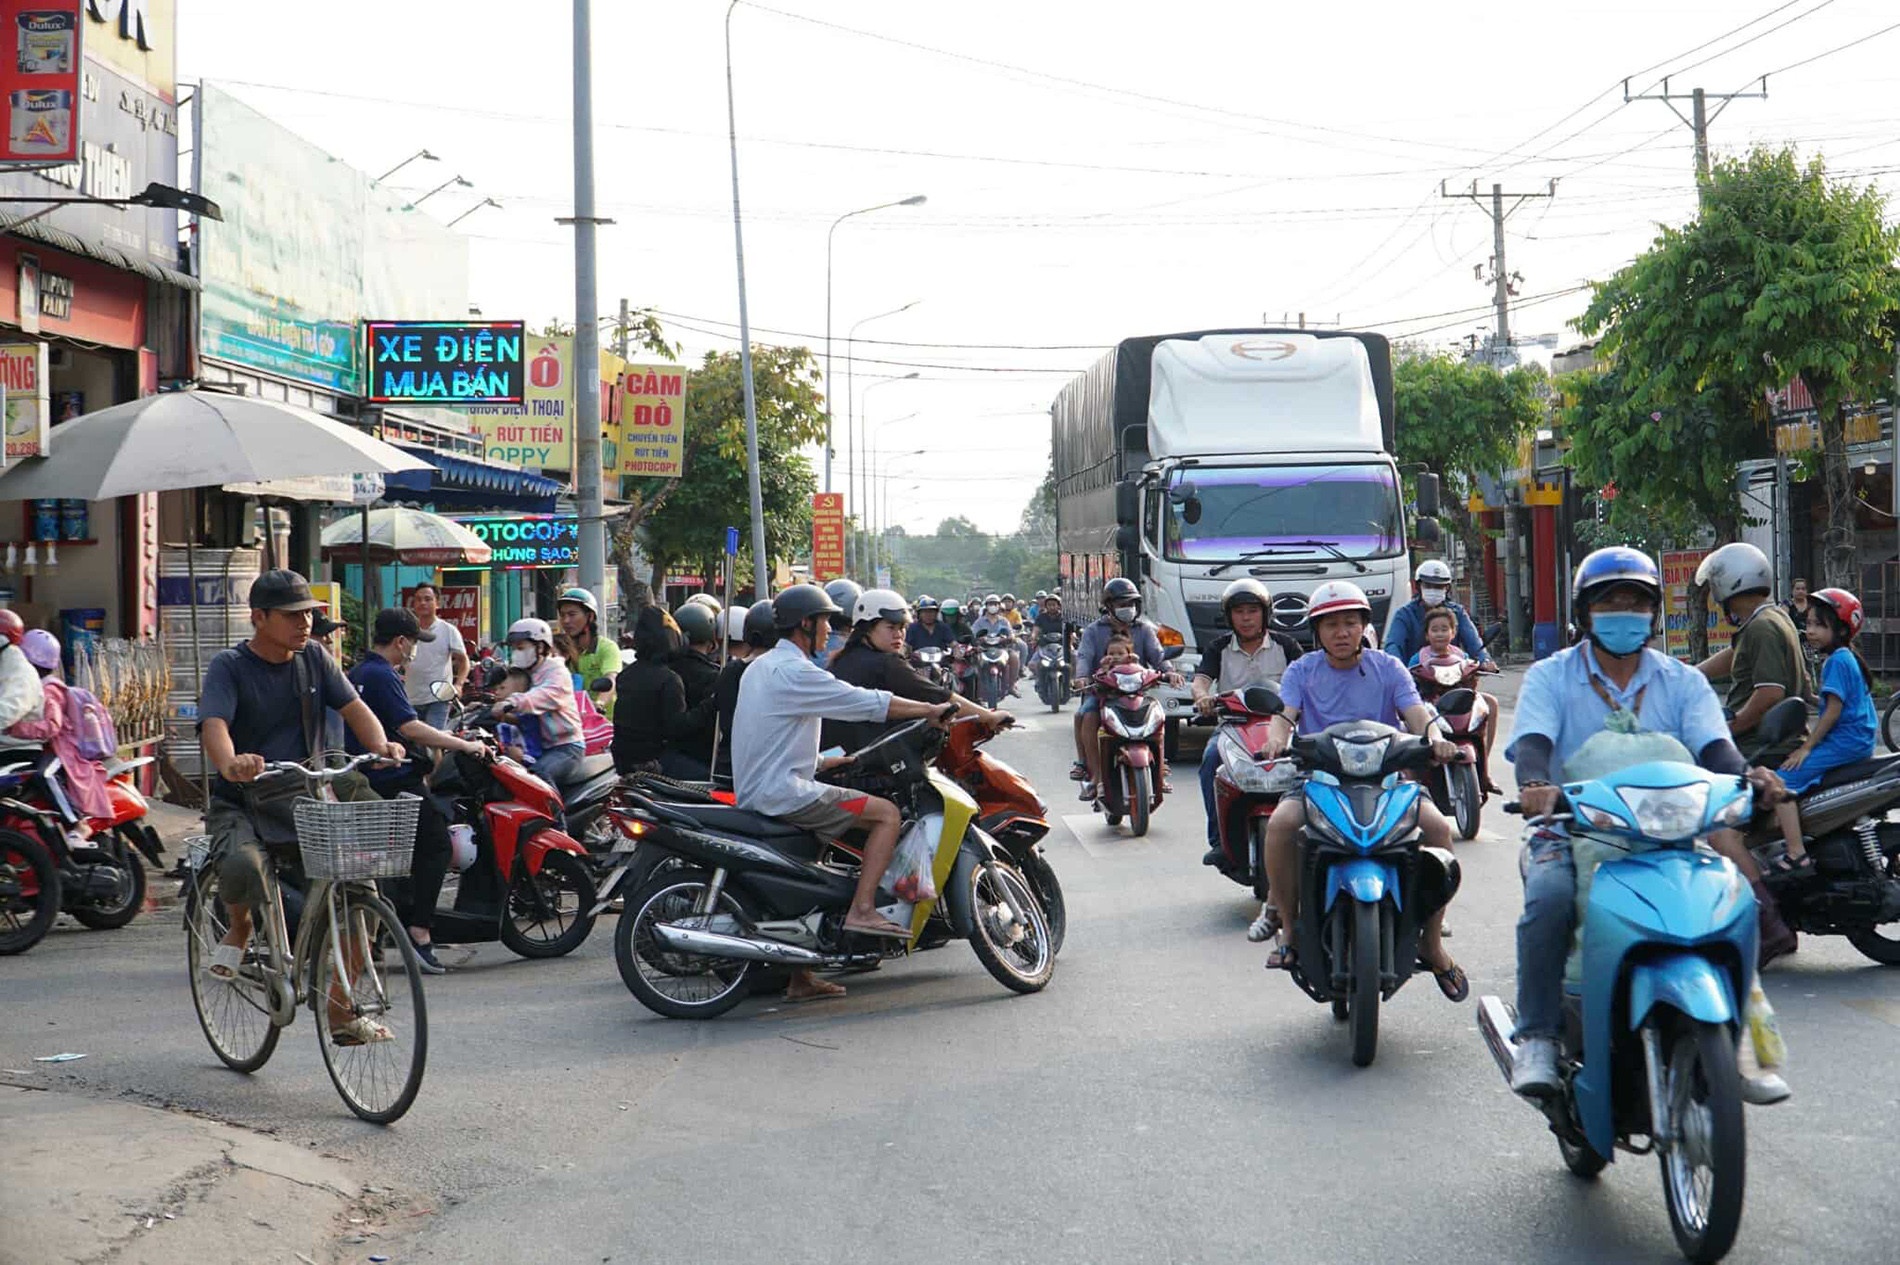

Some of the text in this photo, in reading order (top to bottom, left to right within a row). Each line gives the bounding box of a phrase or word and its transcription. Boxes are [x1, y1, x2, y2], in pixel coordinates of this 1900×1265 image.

[28, 20, 62, 30] Dulux
[378, 335, 422, 363] XE
[384, 366, 509, 397] MUA BÁN
[626, 367, 683, 397] CẦM
[532, 399, 564, 420] THOẠI
[634, 399, 673, 427] ĐỒ
[624, 460, 678, 472] PHOTOCOPY
